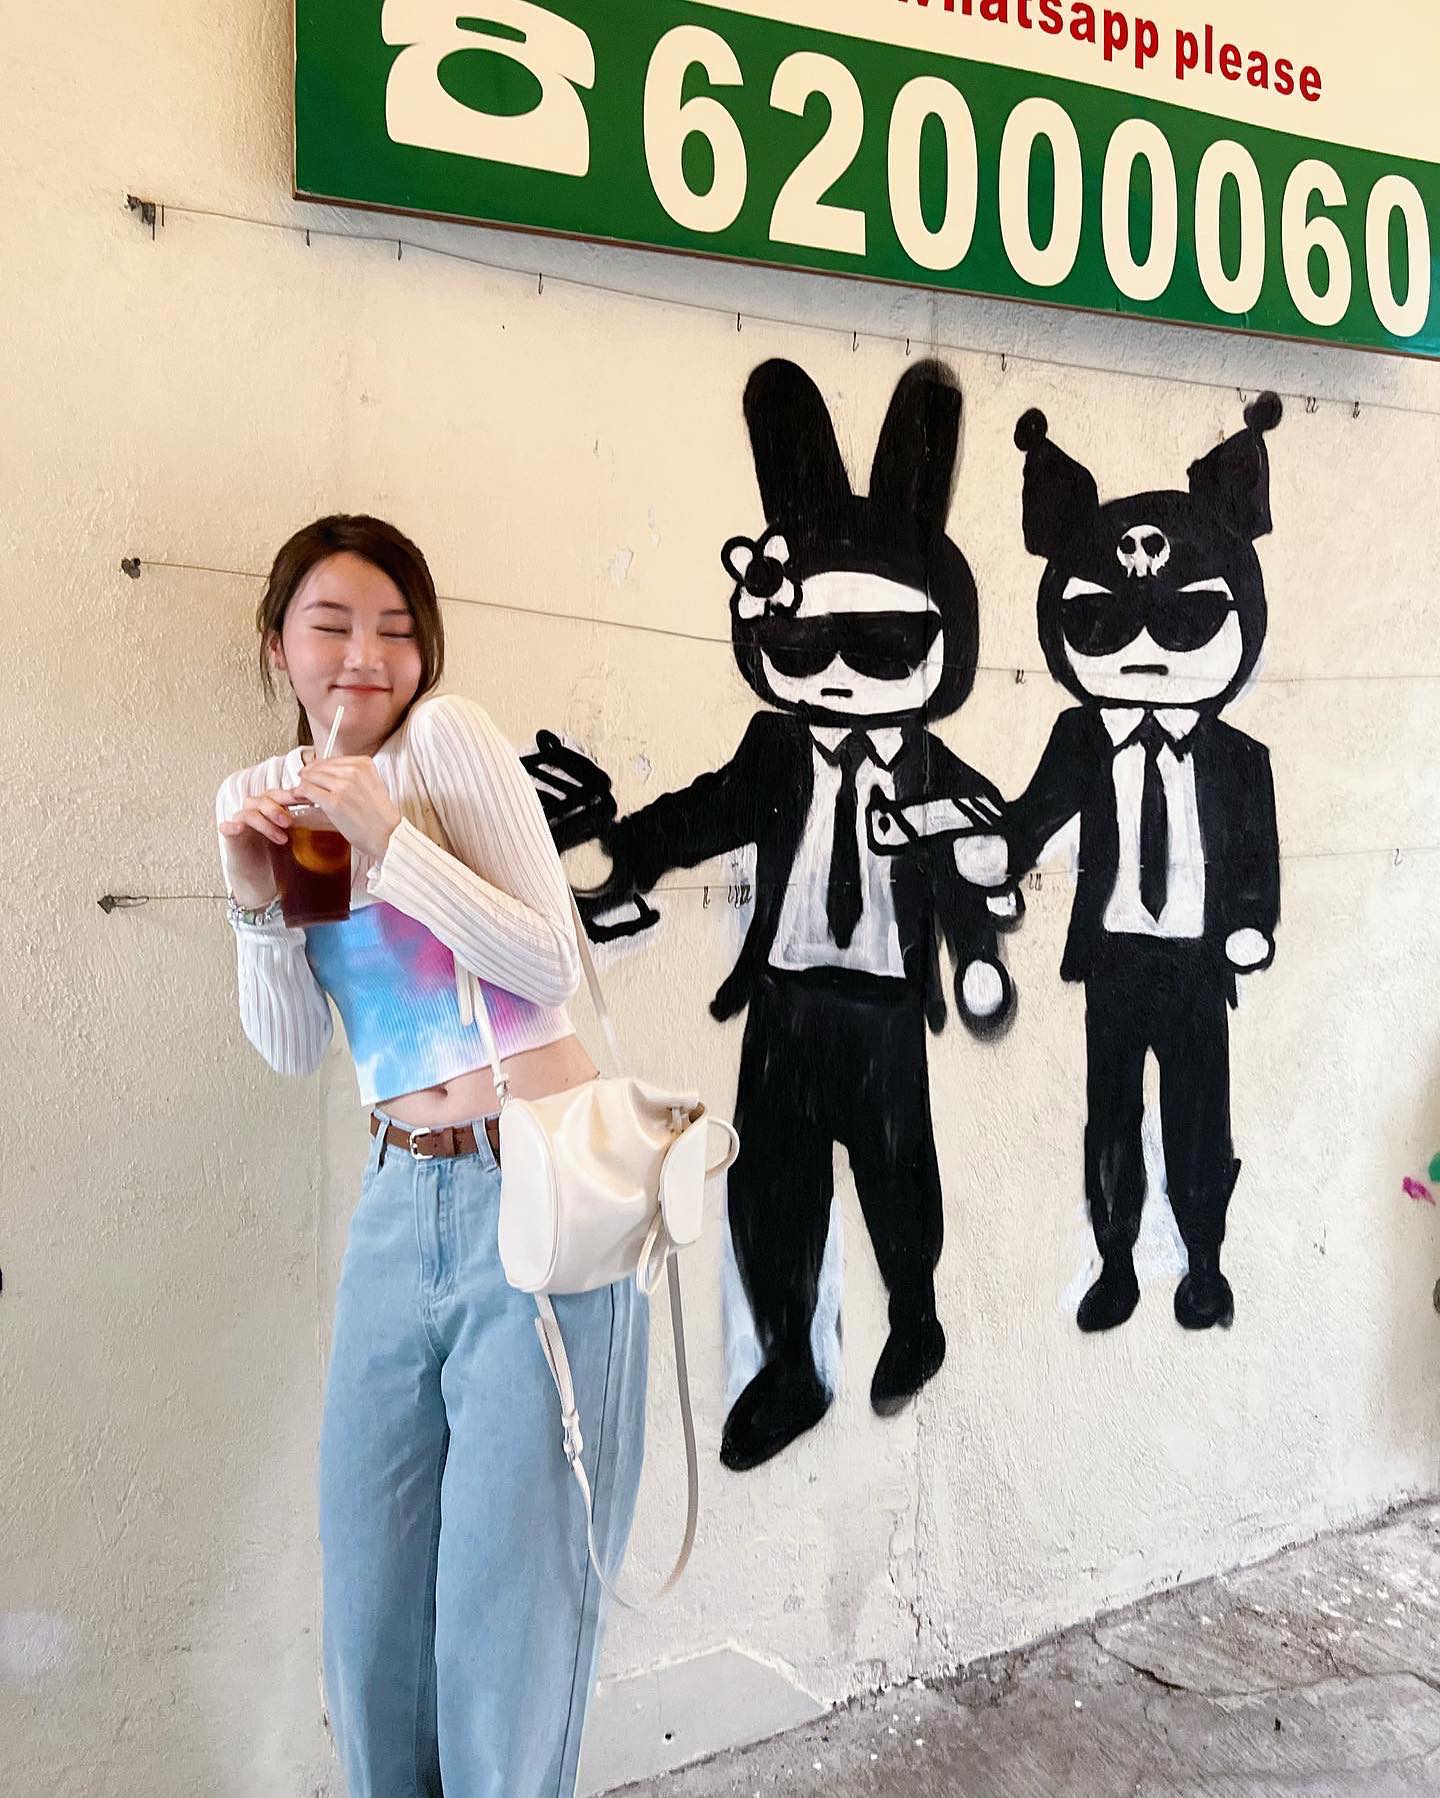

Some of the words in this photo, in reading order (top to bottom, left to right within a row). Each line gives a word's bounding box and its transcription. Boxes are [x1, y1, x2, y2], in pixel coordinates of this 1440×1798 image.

[898, 0, 1159, 69] atsapp
[1175, 23, 1322, 102] please
[643, 24, 1431, 337] 62000060
